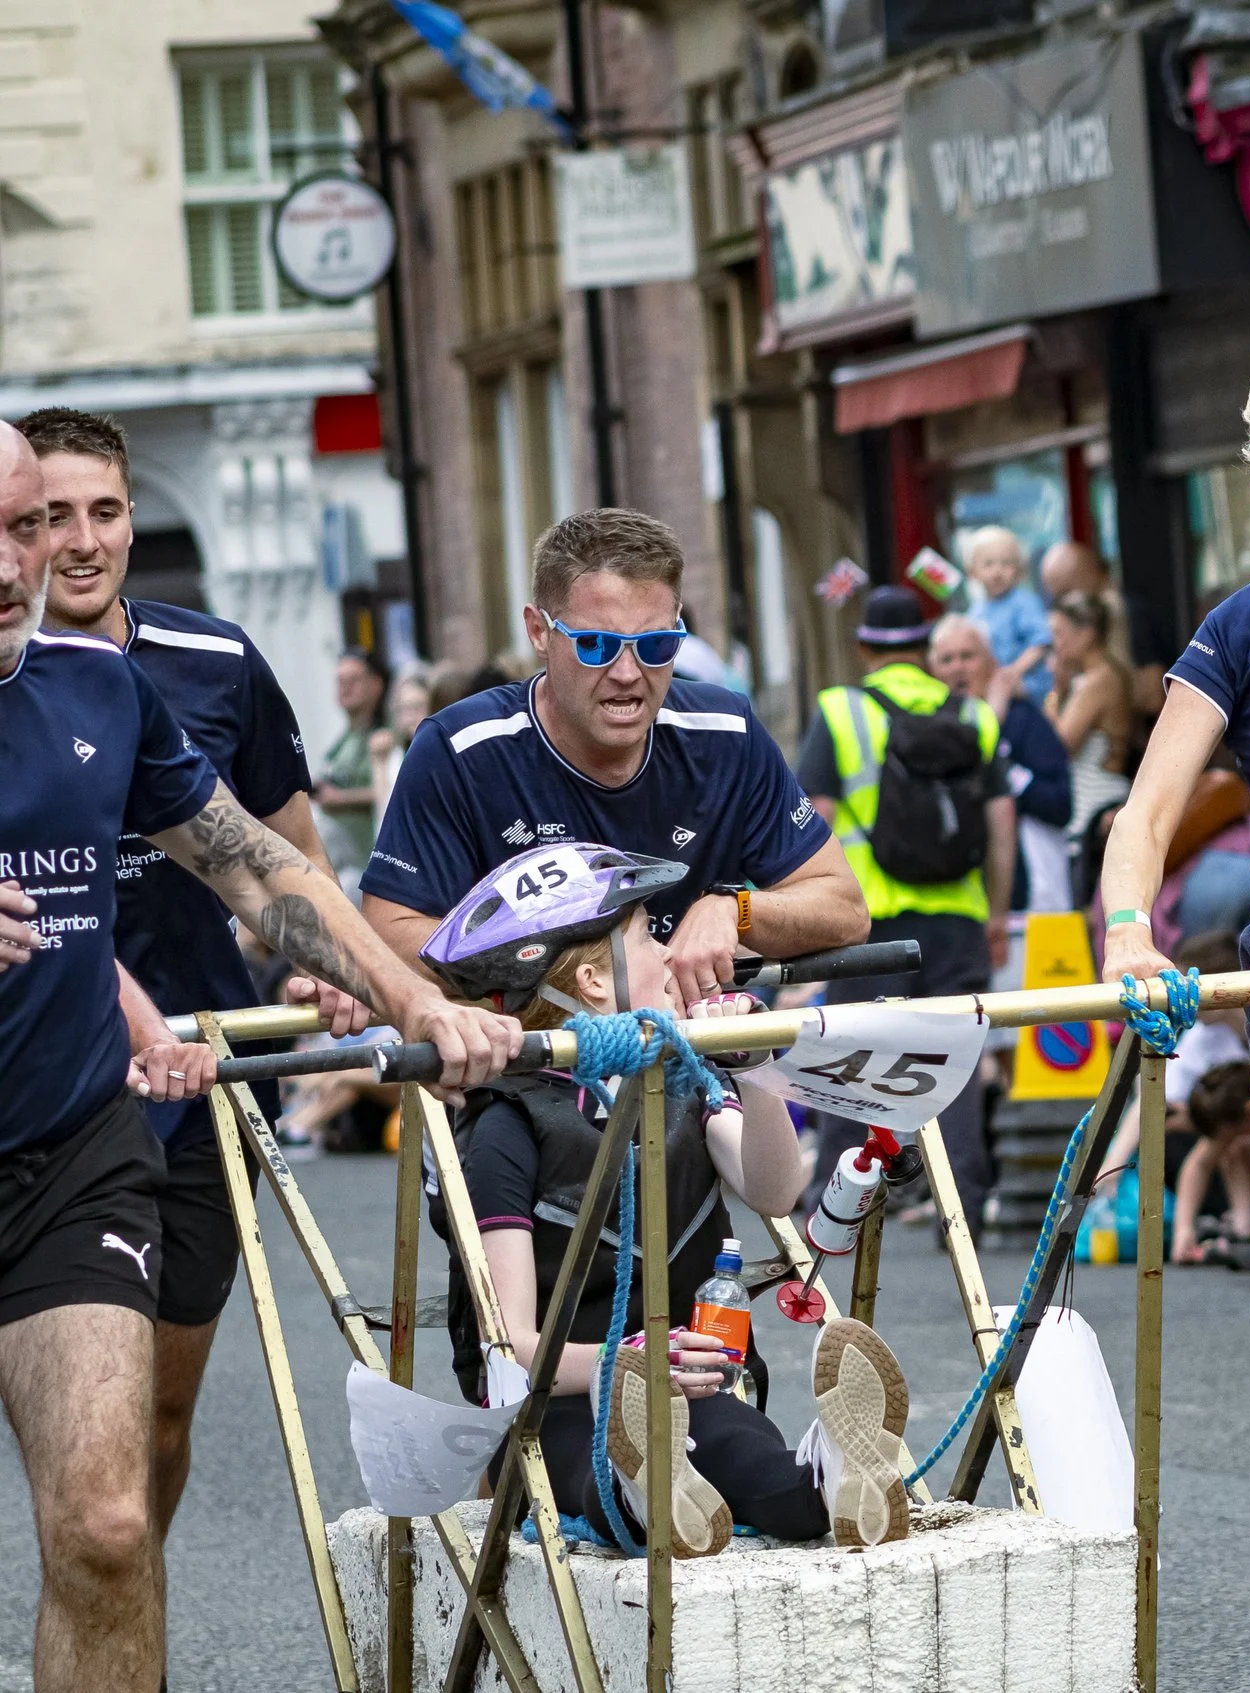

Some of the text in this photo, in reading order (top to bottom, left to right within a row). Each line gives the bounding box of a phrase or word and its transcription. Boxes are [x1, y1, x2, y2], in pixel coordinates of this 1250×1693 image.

[537, 823, 566, 835] HSFC
[48, 886, 69, 894] estate
[69, 884, 90, 894] agent
[516, 859, 569, 901] 45
[41, 913, 99, 935] Hambro
[521, 947, 541, 959] BELL
[797, 1049, 949, 1097] 45
[788, 1081, 898, 1112] Piccadilly
